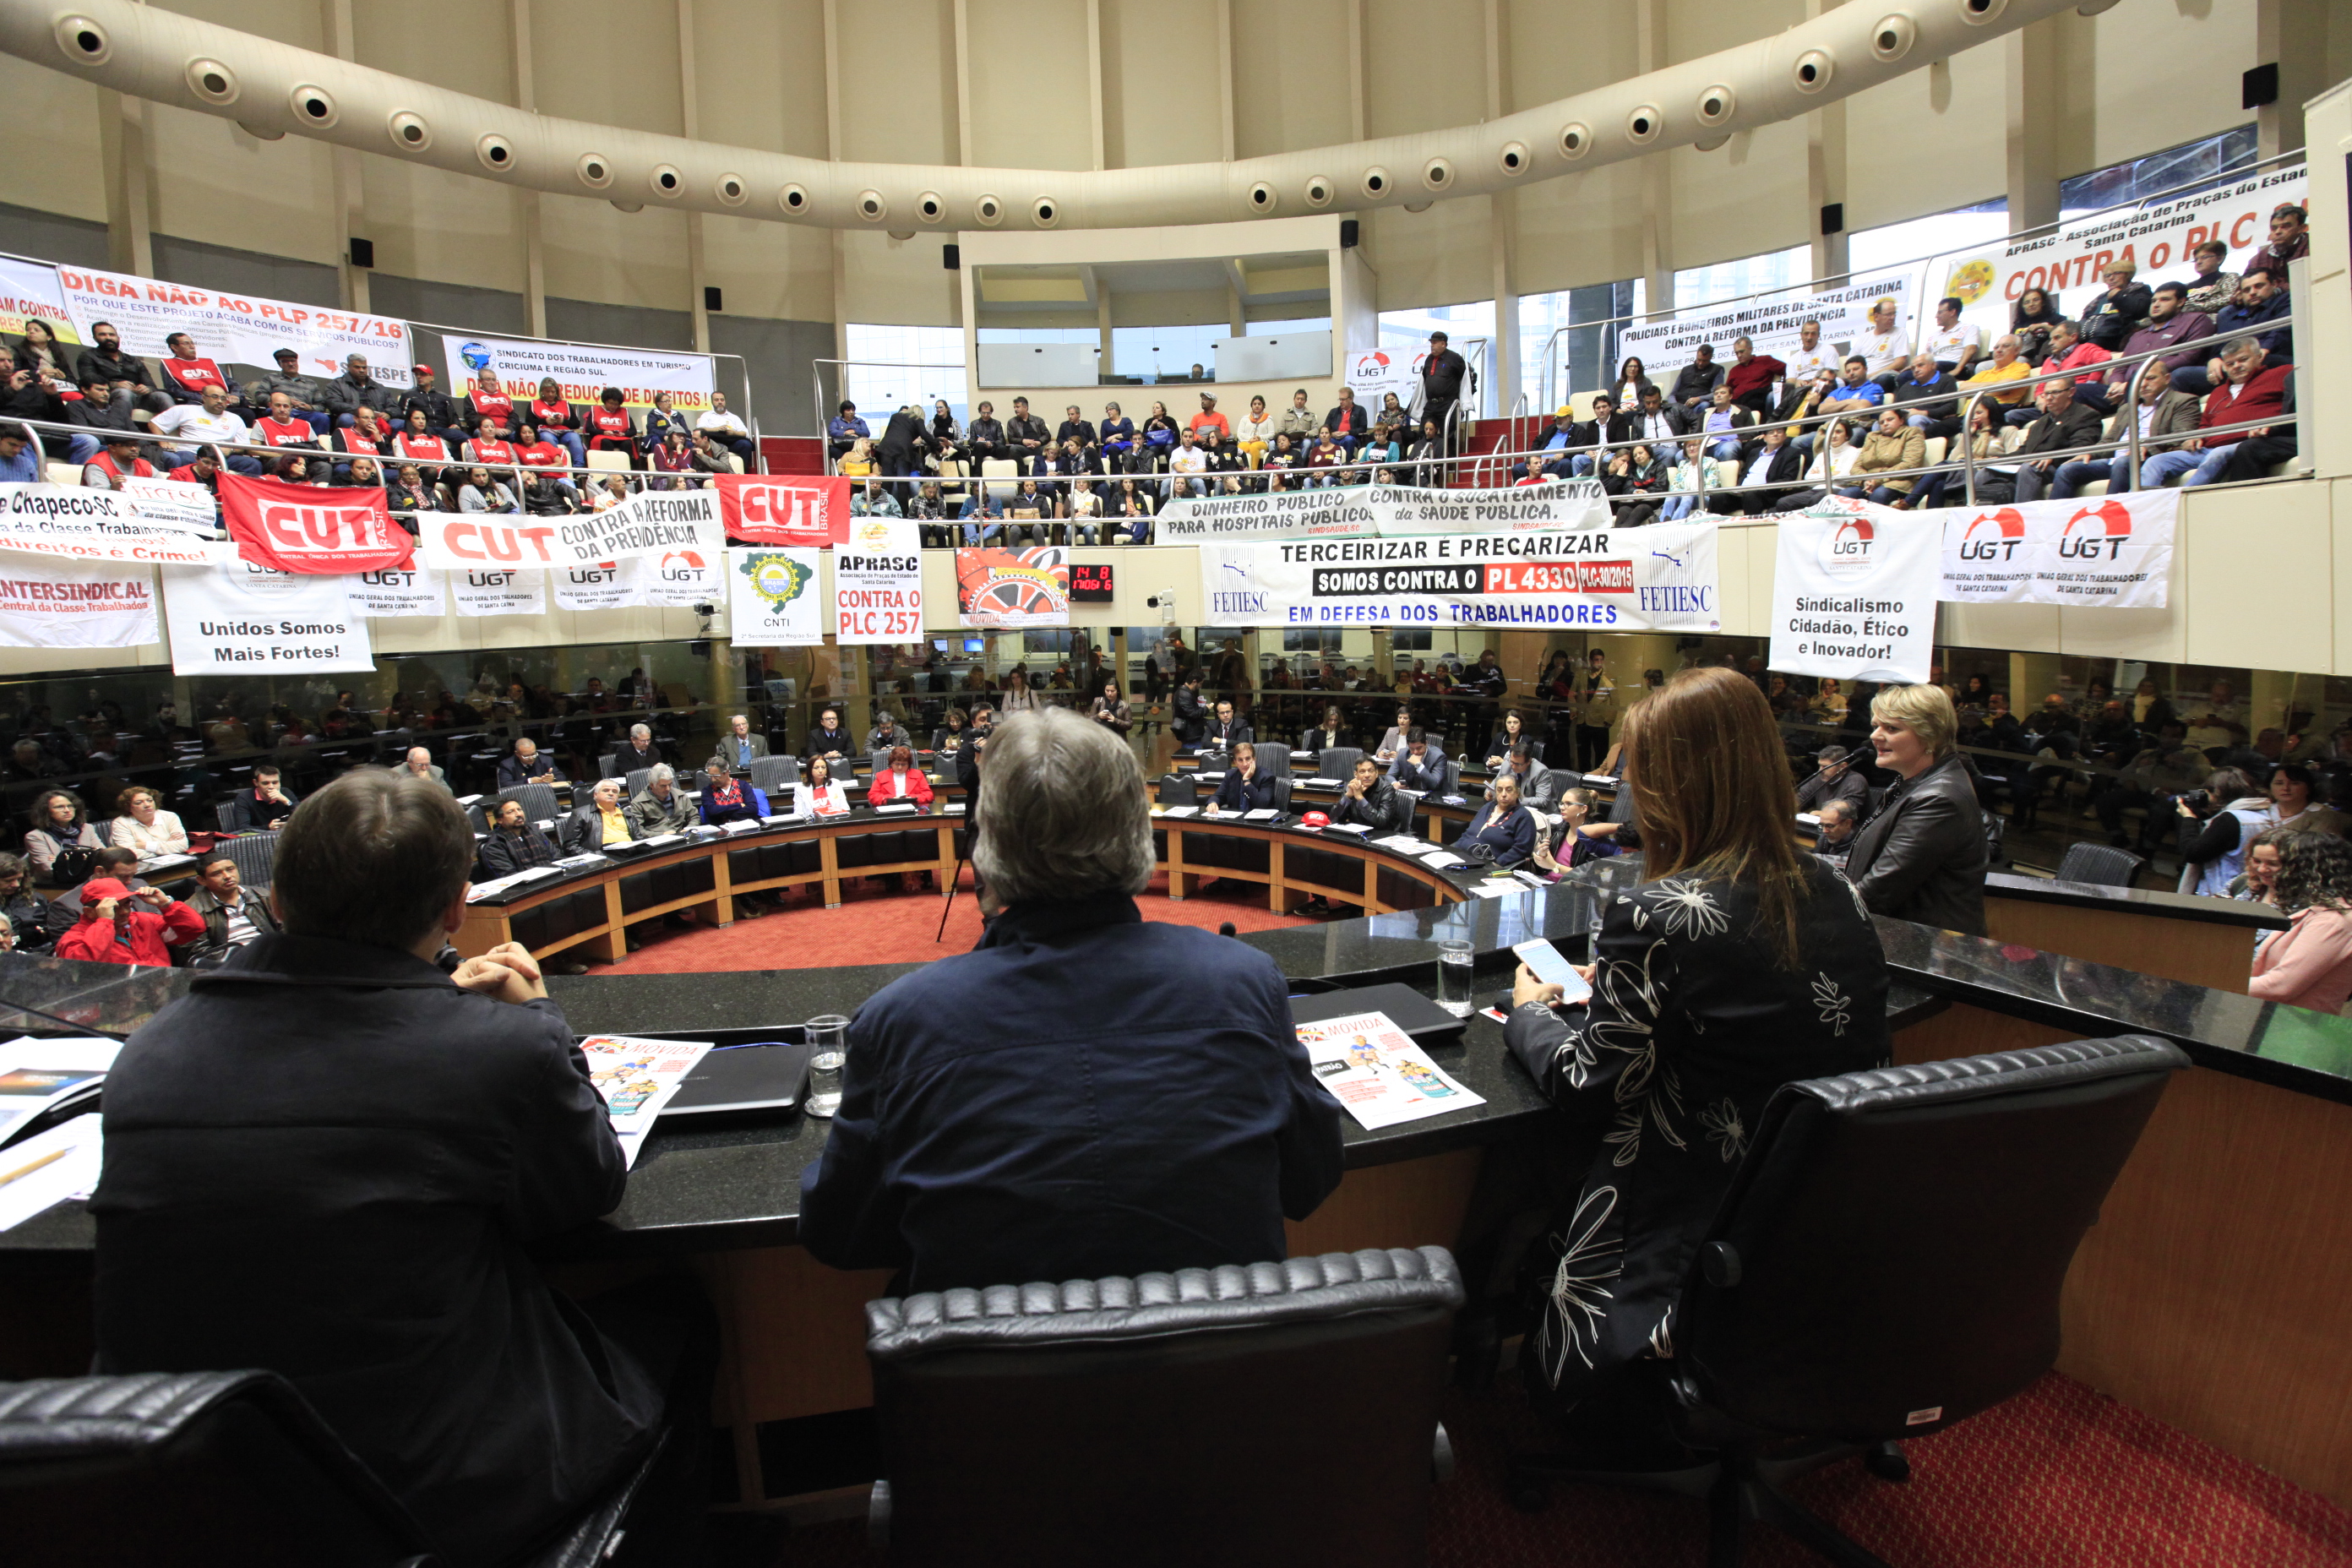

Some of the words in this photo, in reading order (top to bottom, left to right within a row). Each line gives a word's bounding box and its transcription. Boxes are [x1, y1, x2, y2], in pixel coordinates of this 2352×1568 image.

[2006, 237, 2056, 257] APRASC
[2066, 212, 2148, 242] Associação
[2153, 205, 2171, 219] de
[2175, 188, 2232, 212] Praças
[2236, 182, 2256, 196] do
[2084, 231, 2124, 249] Santa
[2129, 213, 2195, 237] Catarina
[19, 300, 69, 322] CONTRA
[61, 271, 139, 299] DIGA
[145, 284, 208, 306] NÃO
[218, 296, 253, 314] AO
[259, 304, 309, 324] PLP
[316, 313, 402, 338] 257/16
[84, 307, 118, 317] Restringe
[1625, 326, 1669, 341] POLICIAIS
[1679, 314, 1734, 333] BOMBEIROS
[1736, 303, 1789, 323] MILITARES
[1845, 280, 1903, 302] CATARINA
[74, 295, 98, 305] POR
[102, 300, 127, 309] QUE
[131, 304, 159, 314] ESTE
[163, 305, 213, 319] PROJETO
[216, 313, 251, 326] ACABA
[254, 320, 277, 331] COM
[347, 335, 399, 350] PÚBLICOS?
[1665, 334, 1701, 350] CONTRA
[1712, 324, 1757, 341] REFORMA
[1760, 321, 1774, 333] DA
[1776, 308, 1847, 329] PREVIDÊNCIA
[497, 350, 544, 361] SINDICATO
[547, 354, 565, 362] DOS
[567, 355, 639, 367] TRABALHADORES
[641, 360, 653, 368] EM
[656, 362, 691, 370] TURISMO
[498, 362, 542, 372] CRICIÚMA
[553, 364, 585, 374] REGIÃO
[589, 368, 607, 377] SUL.
[182, 369, 208, 378] CUT
[1358, 366, 1390, 377] UGT
[507, 378, 536, 397] NÃO
[1370, 490, 1434, 504] CONTRA
[1439, 491, 1449, 504] O
[1454, 482, 1601, 504] SUCATEAMENTO
[743, 487, 818, 529] CUT
[819, 488, 829, 530] BRASIL
[1192, 499, 1267, 517] DINHEIRO
[1277, 493, 1344, 512] PÚBLICO
[1396, 508, 1413, 520] da
[1419, 505, 1469, 520] SAÚDE
[1476, 504, 1558, 520] PÚBLICA.
[40, 522, 91, 535] Classe
[266, 506, 373, 549] CUT
[444, 522, 554, 561] CUT
[561, 509, 630, 545] CONTRA
[631, 502, 644, 521] A
[645, 498, 713, 522] REFORMA
[1168, 520, 1206, 534] PARA
[1212, 514, 1293, 531] HOSPITAIS
[133, 547, 208, 561] Crime!
[574, 542, 602, 560] DA
[1281, 541, 1427, 563] TERCEIRIZAR
[1438, 536, 1451, 558] É
[1461, 534, 1609, 557] PRECARIZAR
[1834, 542, 1873, 555] UGT
[1960, 539, 2023, 561] UGT
[2060, 536, 2131, 561] UGT
[840, 556, 917, 571] APRASC
[362, 570, 416, 587] UGT
[469, 572, 515, 587] UGT
[569, 569, 617, 583] UGT
[662, 569, 705, 581] UGT
[1319, 572, 1379, 592] SOMOS
[1384, 569, 1459, 591] CONTRA
[1464, 569, 1477, 585] O
[1489, 569, 1517, 590] PL
[1521, 567, 1576, 590] 4330
[1580, 566, 1632, 588] PLC-30/2015
[2089, 573, 2148, 582] TRABALHADORES
[838, 591, 904, 607] CONTRA
[910, 591, 920, 607] O
[1640, 585, 1712, 612] FETIESC
[2066, 585, 2082, 594] SANTA
[2085, 586, 2117, 595] CATARINA
[39, 602, 52, 612] da
[55, 602, 85, 612] Classe
[88, 602, 148, 612] Trabalhadora
[1213, 591, 1268, 612] FETIESC
[1796, 597, 1903, 613] Sindicalismo
[764, 618, 790, 627] CNTI
[841, 612, 876, 634] PLC
[885, 612, 920, 634] 257
[970, 613, 999, 623] MOVIDA
[1289, 607, 1313, 623] EM
[1320, 606, 1391, 621] DEFESA
[1401, 605, 1438, 621] DOS
[1450, 604, 1617, 623] TRABALHADORES
[200, 621, 275, 635] Unidos
[280, 621, 346, 634] Somos
[1789, 618, 1858, 638] Cidadão,
[1864, 617, 1908, 637] Ético
[215, 647, 264, 662] Mais
[271, 645, 339, 660] Fortes!
[1799, 643, 1808, 654] e
[1813, 641, 1891, 659] Inovador!
[1327, 1018, 1384, 1037] MOVIDA
[629, 1043, 698, 1055] MOVIDA
[1315, 1062, 1343, 1074] PATRÃO
